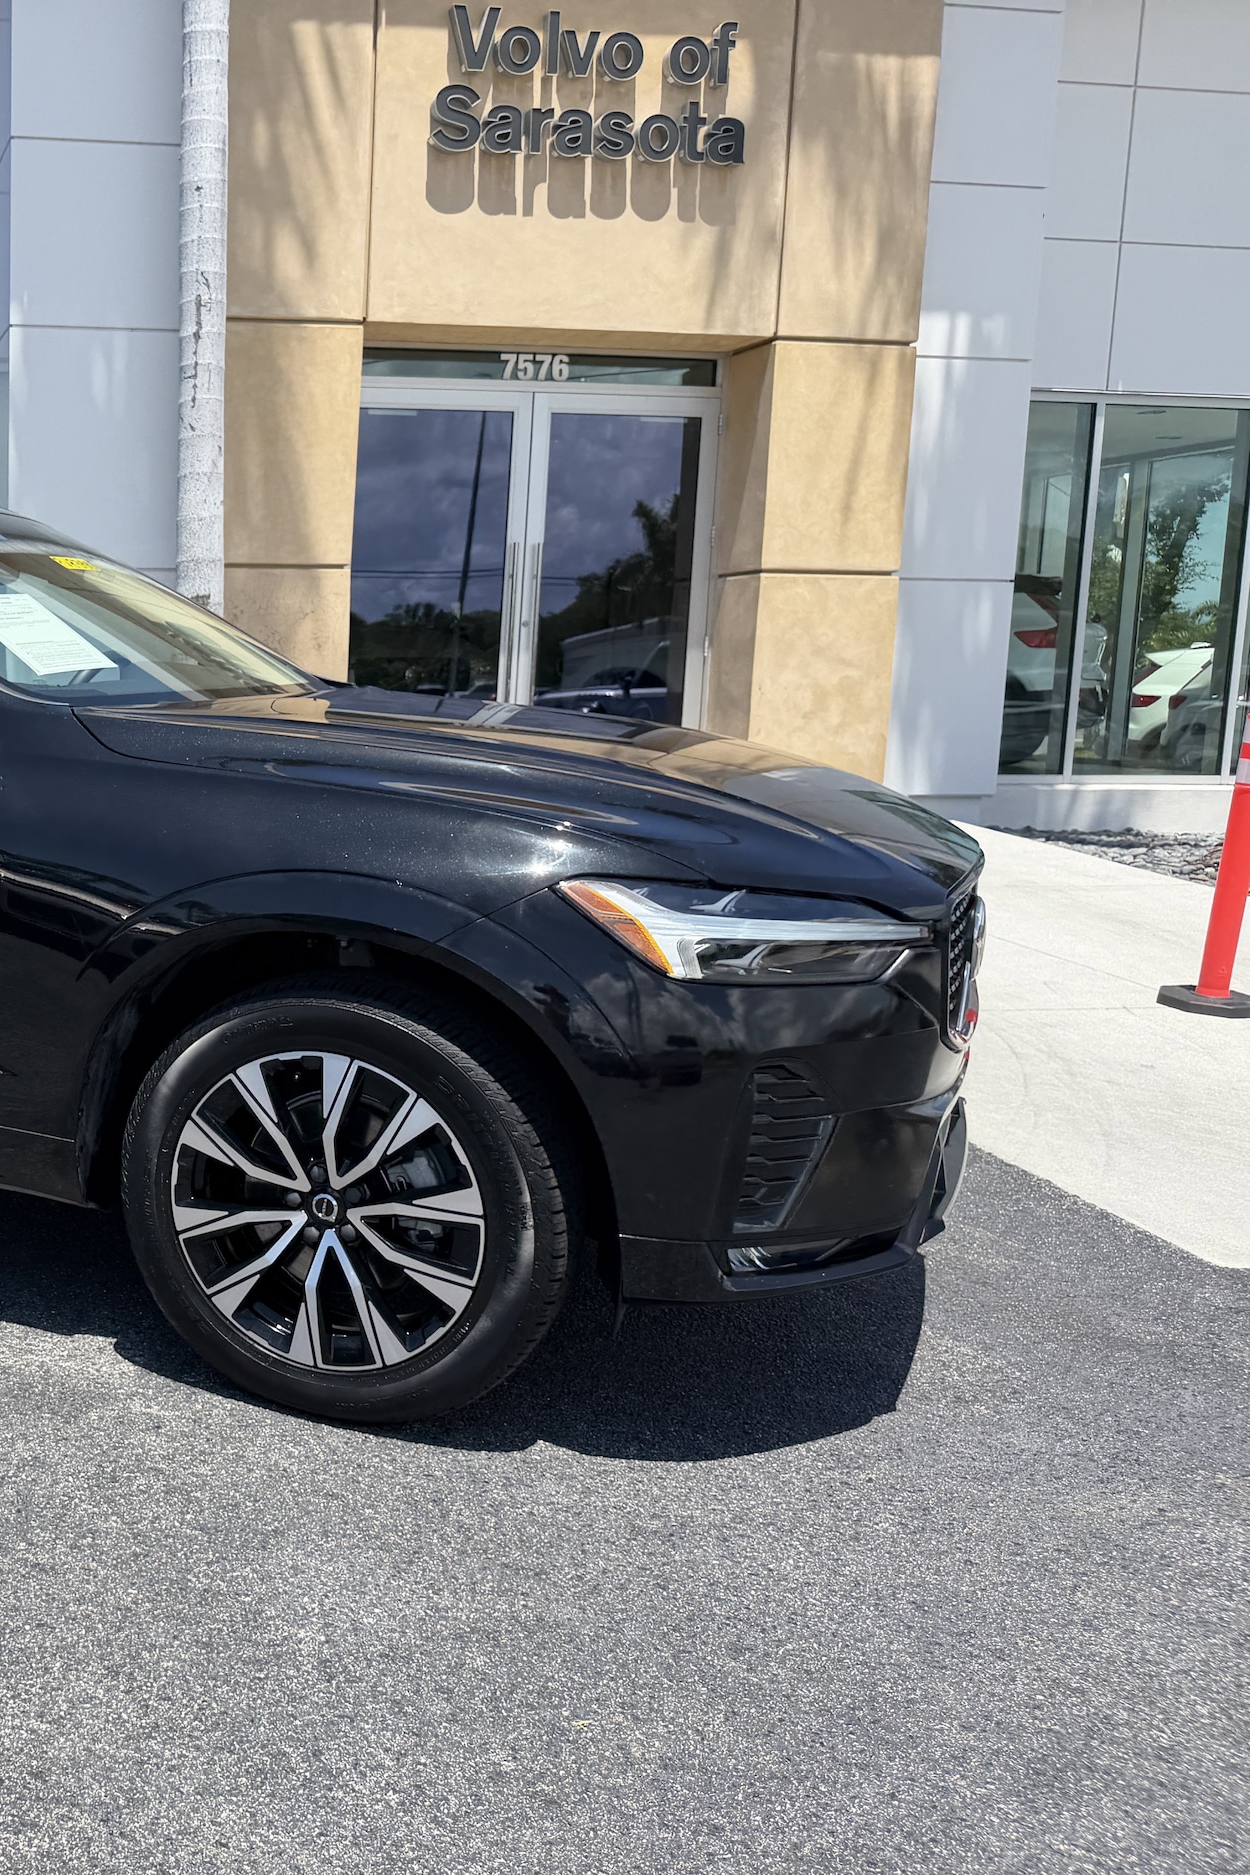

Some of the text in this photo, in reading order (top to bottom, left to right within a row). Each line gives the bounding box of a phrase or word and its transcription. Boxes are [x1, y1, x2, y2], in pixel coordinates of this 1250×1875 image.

[448, 4, 740, 88] Volvo of
[428, 83, 747, 166] Sarasota
[500, 353, 570, 382] 7576
